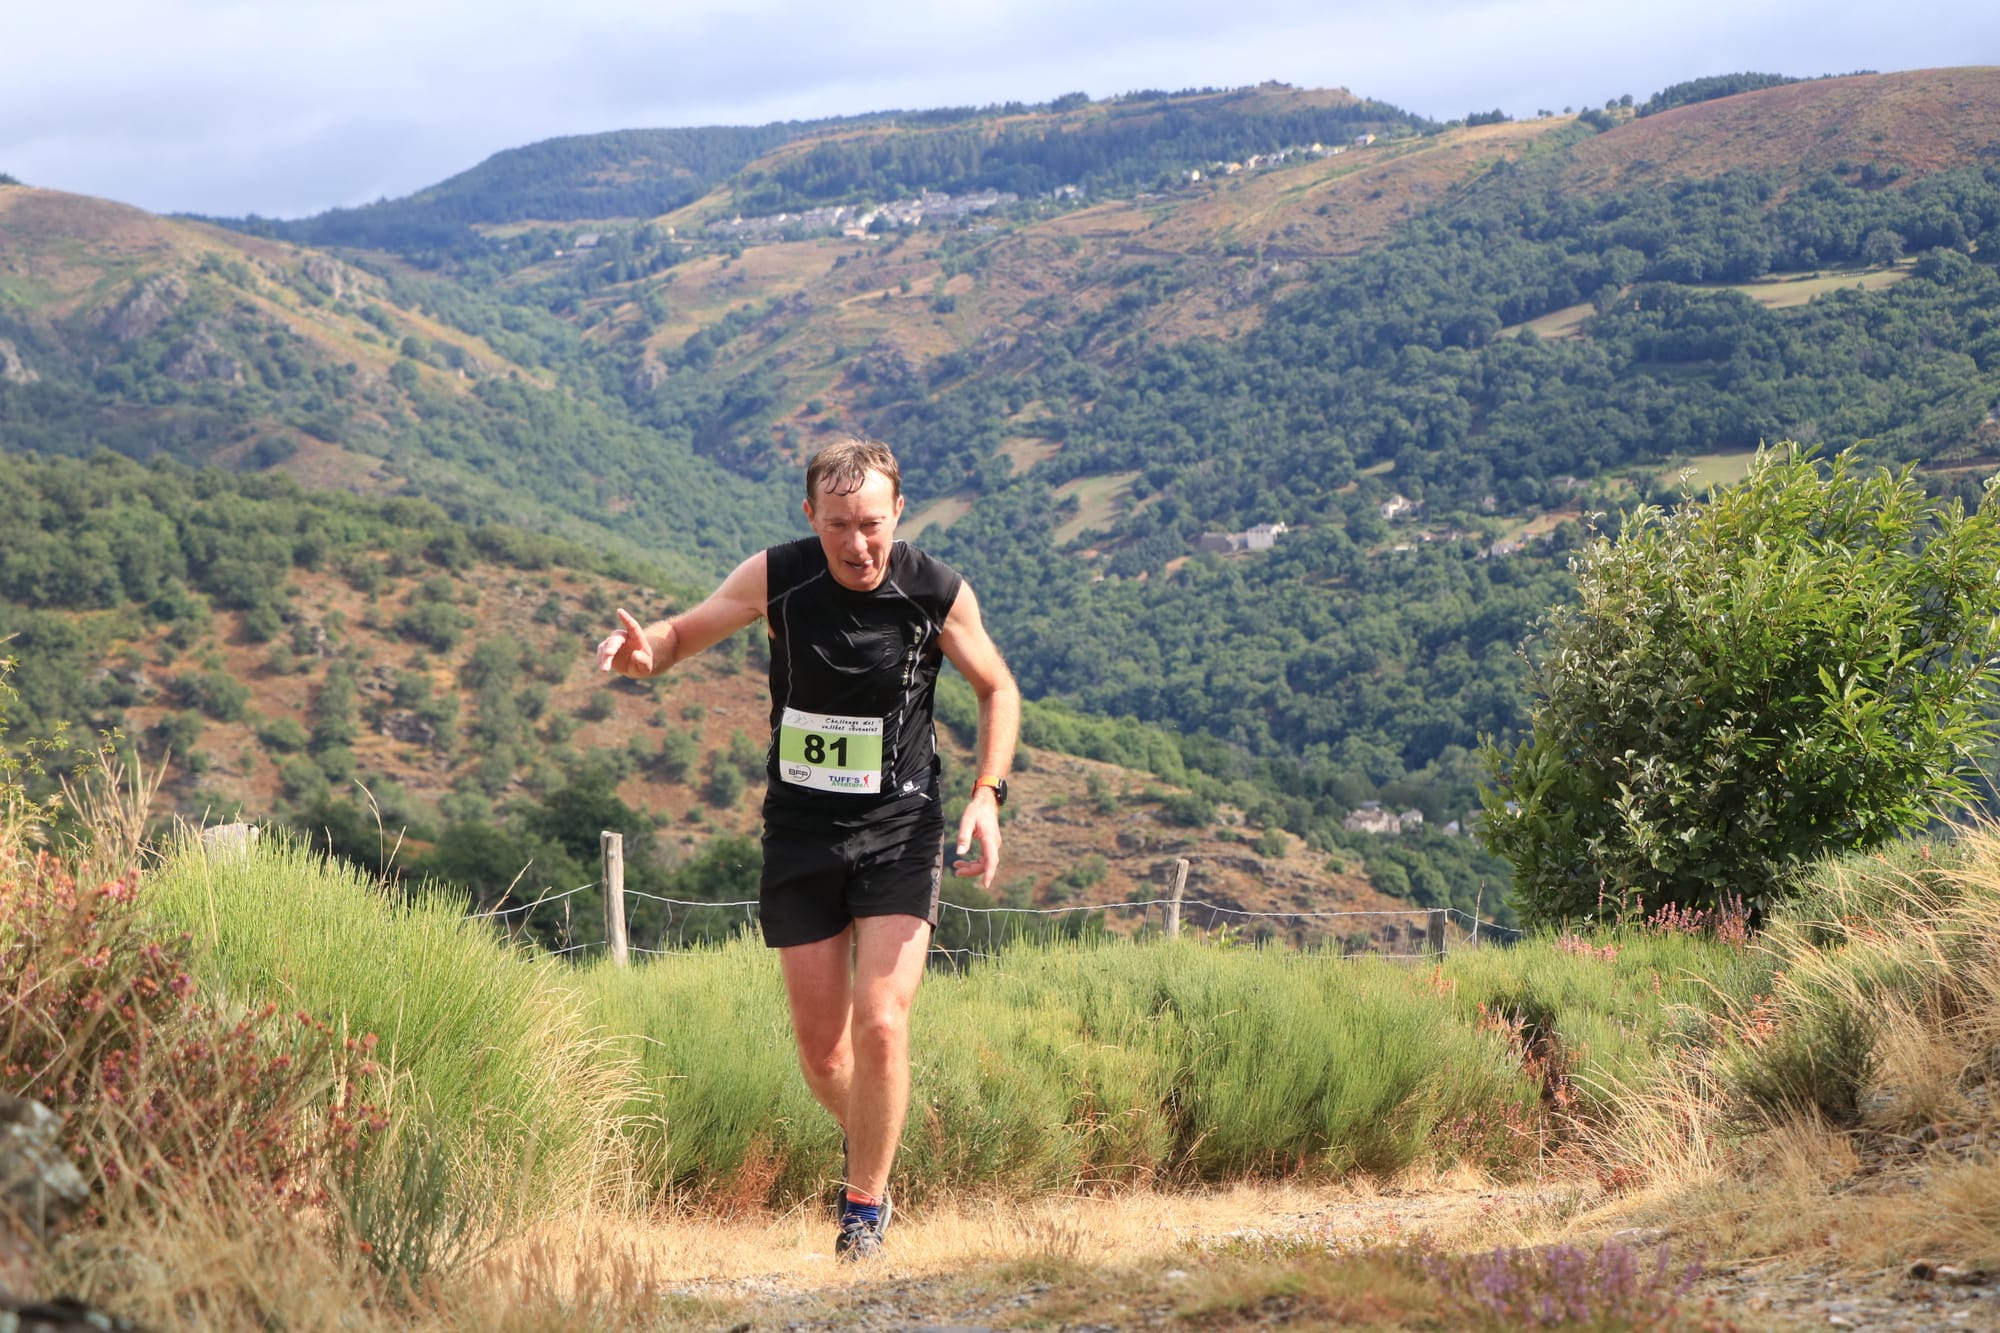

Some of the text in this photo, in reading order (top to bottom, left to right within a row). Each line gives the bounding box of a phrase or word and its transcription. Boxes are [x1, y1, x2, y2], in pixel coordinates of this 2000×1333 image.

[825, 718, 859, 727] Challenge
[804, 734, 848, 767] 81
[829, 775, 860, 783] TUFF'S
